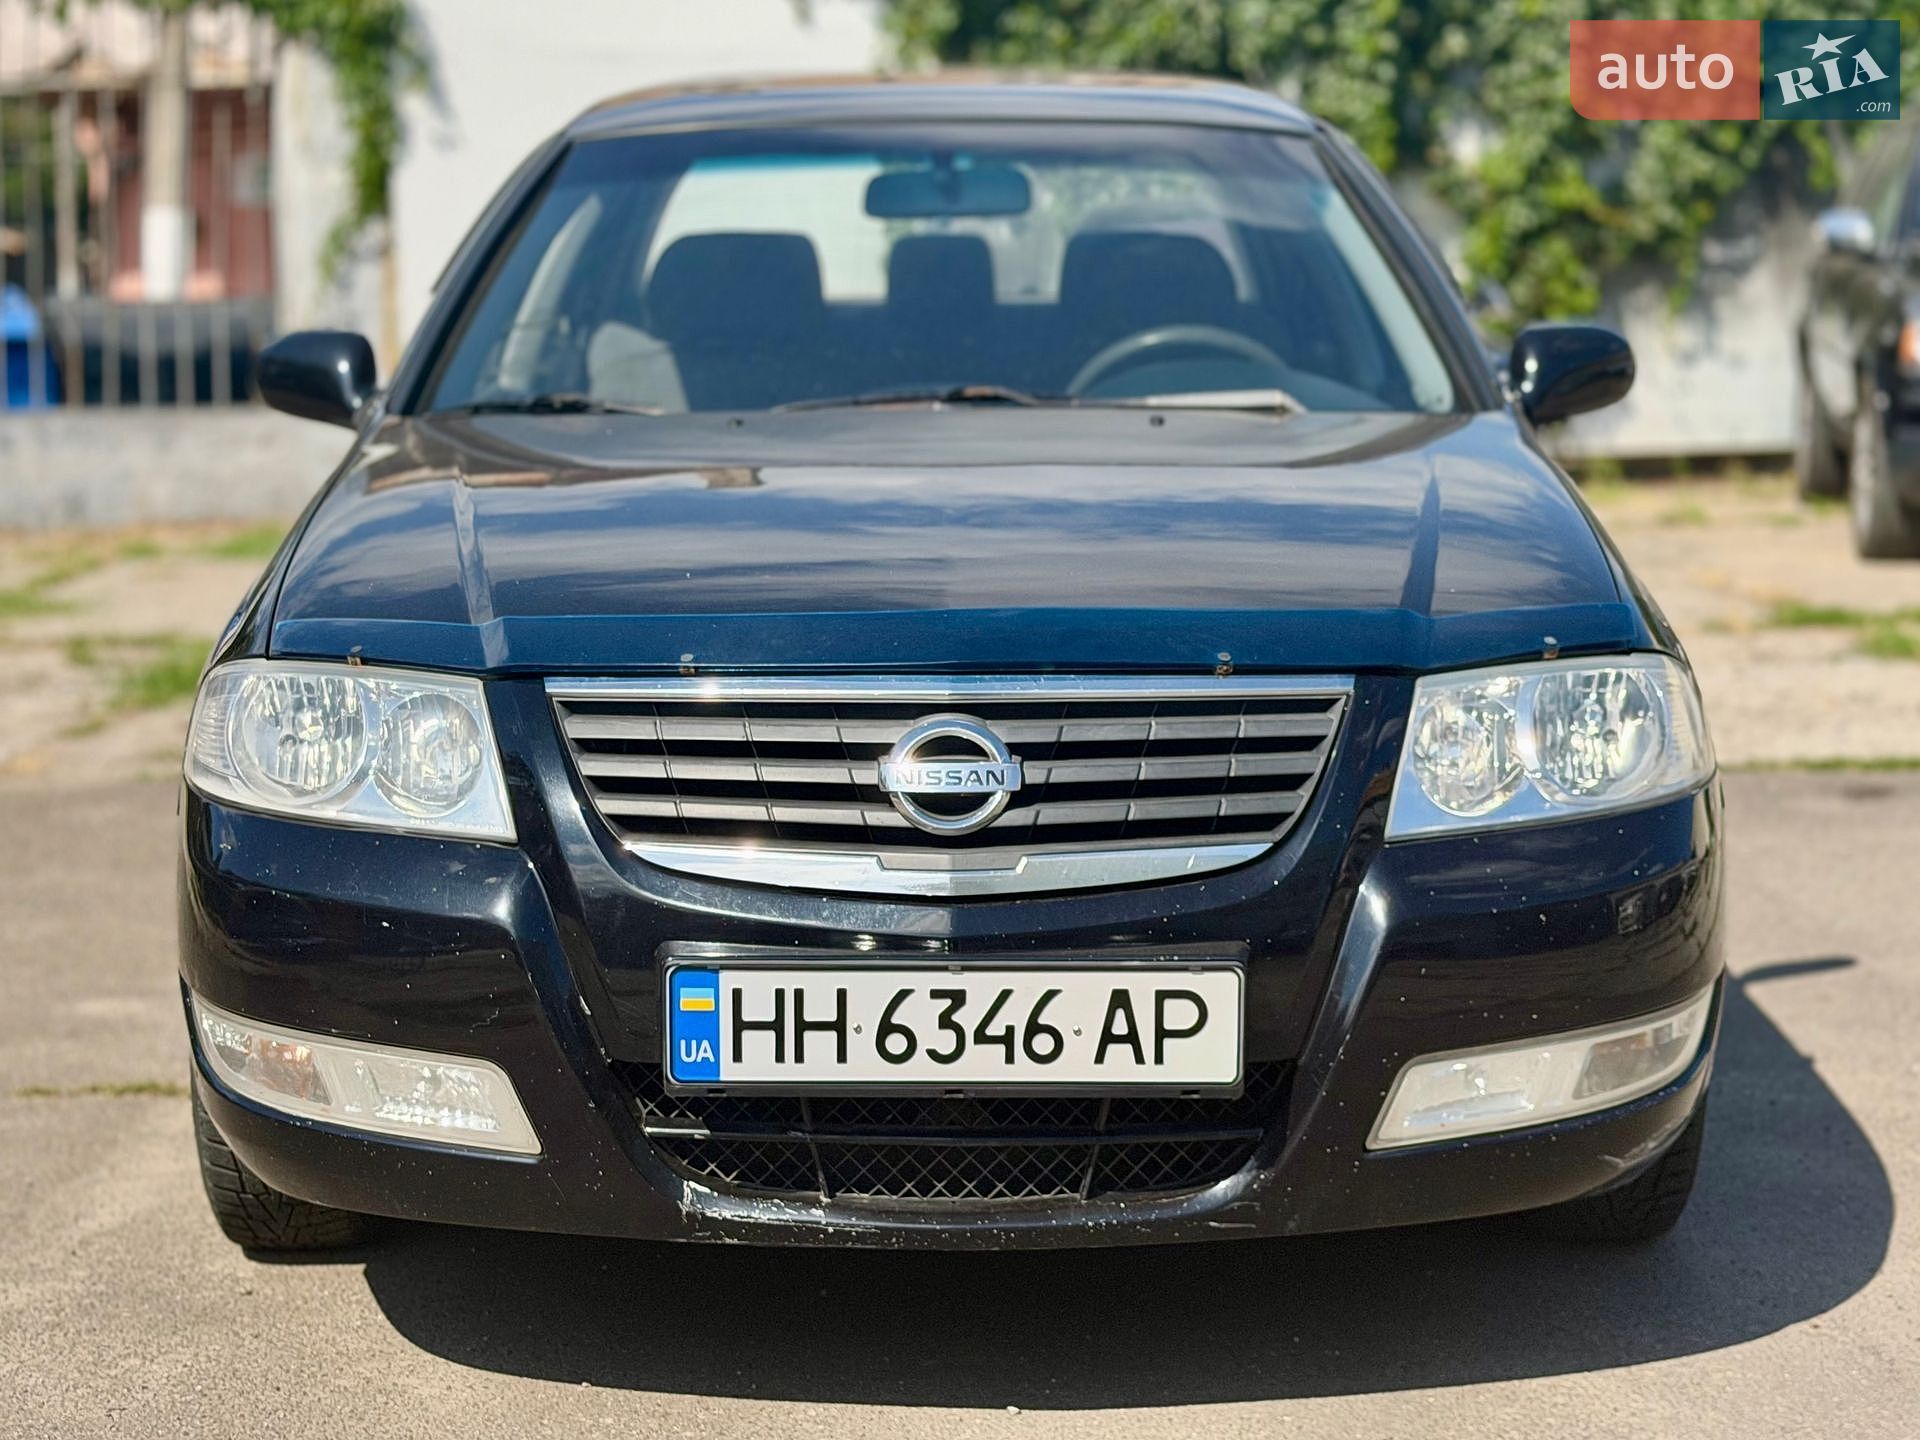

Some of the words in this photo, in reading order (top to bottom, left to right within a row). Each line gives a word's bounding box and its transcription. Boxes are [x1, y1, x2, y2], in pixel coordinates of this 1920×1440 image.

[895, 769, 1005, 787] NISSAN
[731, 987, 848, 1065] HH
[875, 988, 1064, 1065] 6346
[1093, 988, 1209, 1066] AP
[679, 1039, 715, 1064] UA
